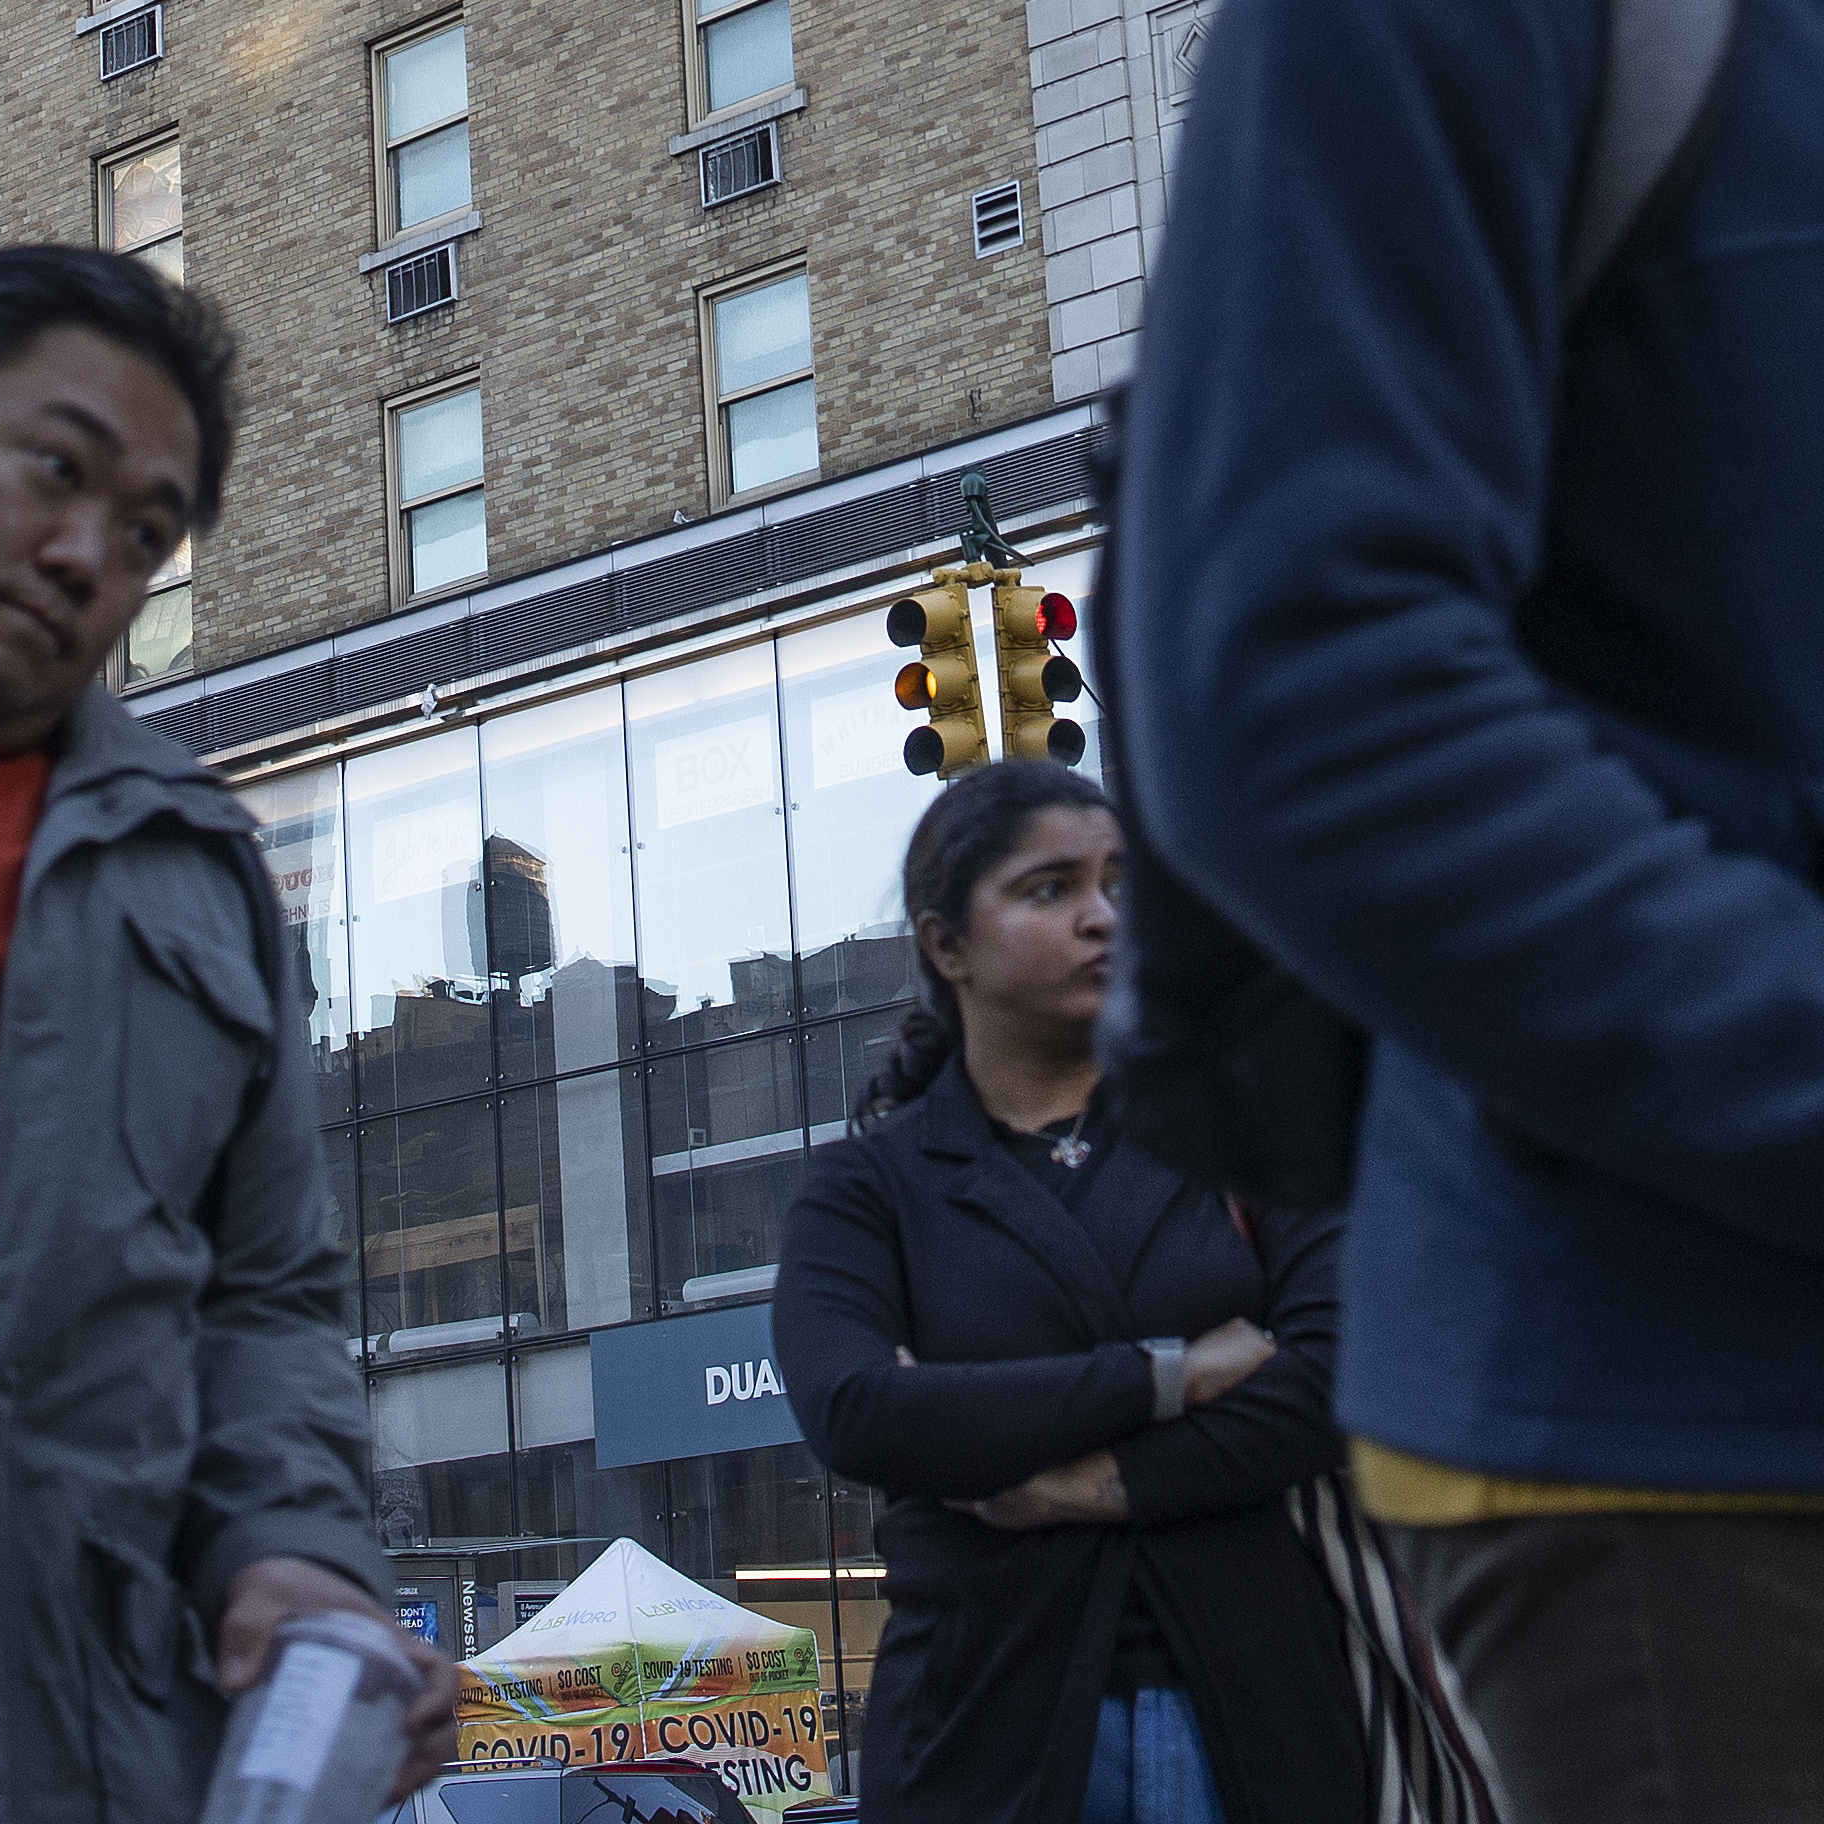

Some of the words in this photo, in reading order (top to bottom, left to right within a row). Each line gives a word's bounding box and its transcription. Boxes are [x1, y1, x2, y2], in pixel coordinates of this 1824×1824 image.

[676, 737, 753, 795] BOX
[662, 782, 771, 825] MEDITERRANEAN
[406, 868, 449, 893] TACOS
[502, 1678, 544, 1700] TESTING
[558, 1669, 572, 1690] $0
[575, 1665, 602, 1687] COST
[643, 1660, 692, 1680] COVID-19
[693, 1657, 734, 1678] TESTING
[746, 1650, 760, 1670] $0
[762, 1649, 786, 1669] COST
[471, 1723, 630, 1764] COVID-19
[659, 1705, 817, 1753] COVID-19
[705, 1754, 812, 1797] STING
